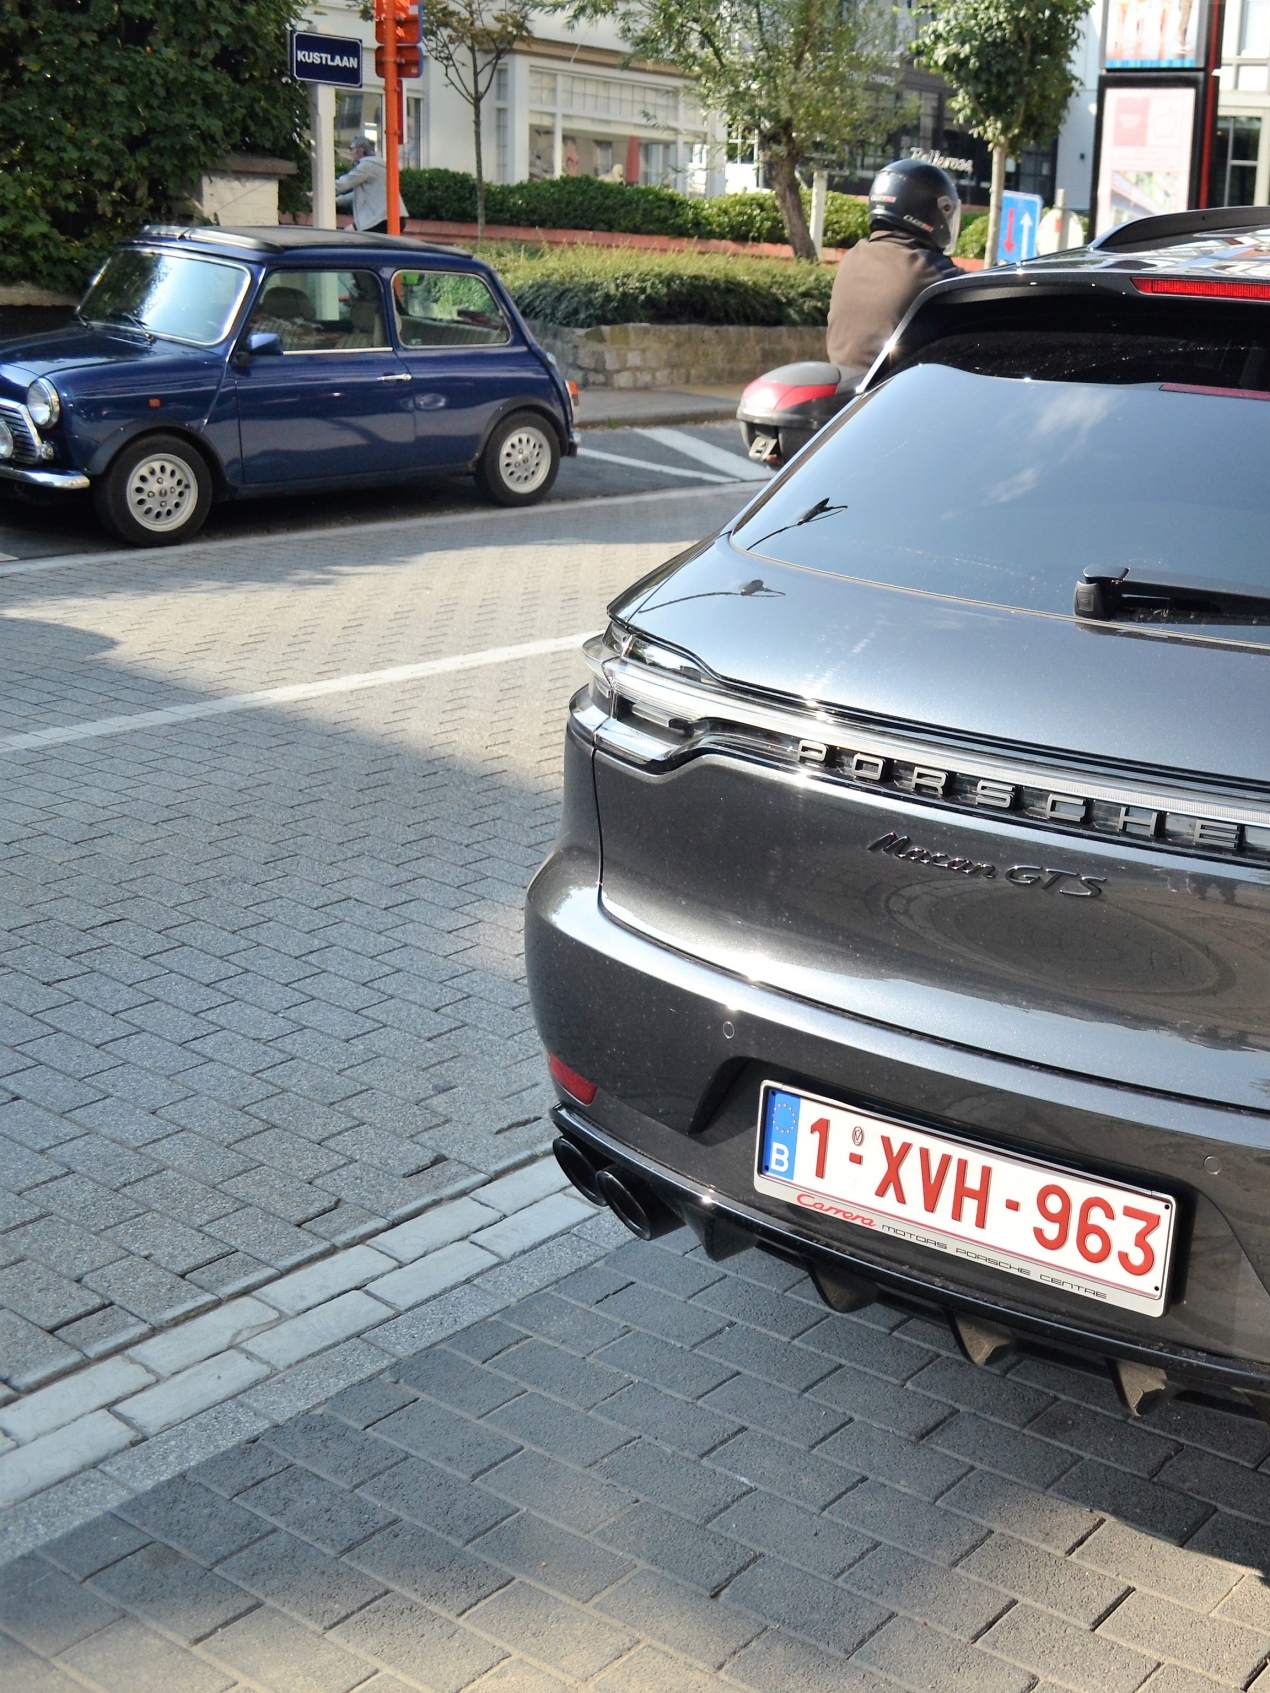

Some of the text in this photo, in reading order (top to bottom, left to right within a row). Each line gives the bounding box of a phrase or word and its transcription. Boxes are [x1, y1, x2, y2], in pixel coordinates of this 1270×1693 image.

[297, 50, 358, 69] KUSTLAAN
[797, 739, 1243, 851] PORSCHE
[867, 831, 1107, 899] Macan GTS
[769, 1141, 790, 1173] B
[810, 1117, 1161, 1276] 1-XVH-963
[796, 1193, 1107, 1300] Carrera MOTORS PORSCHE CENTRE
